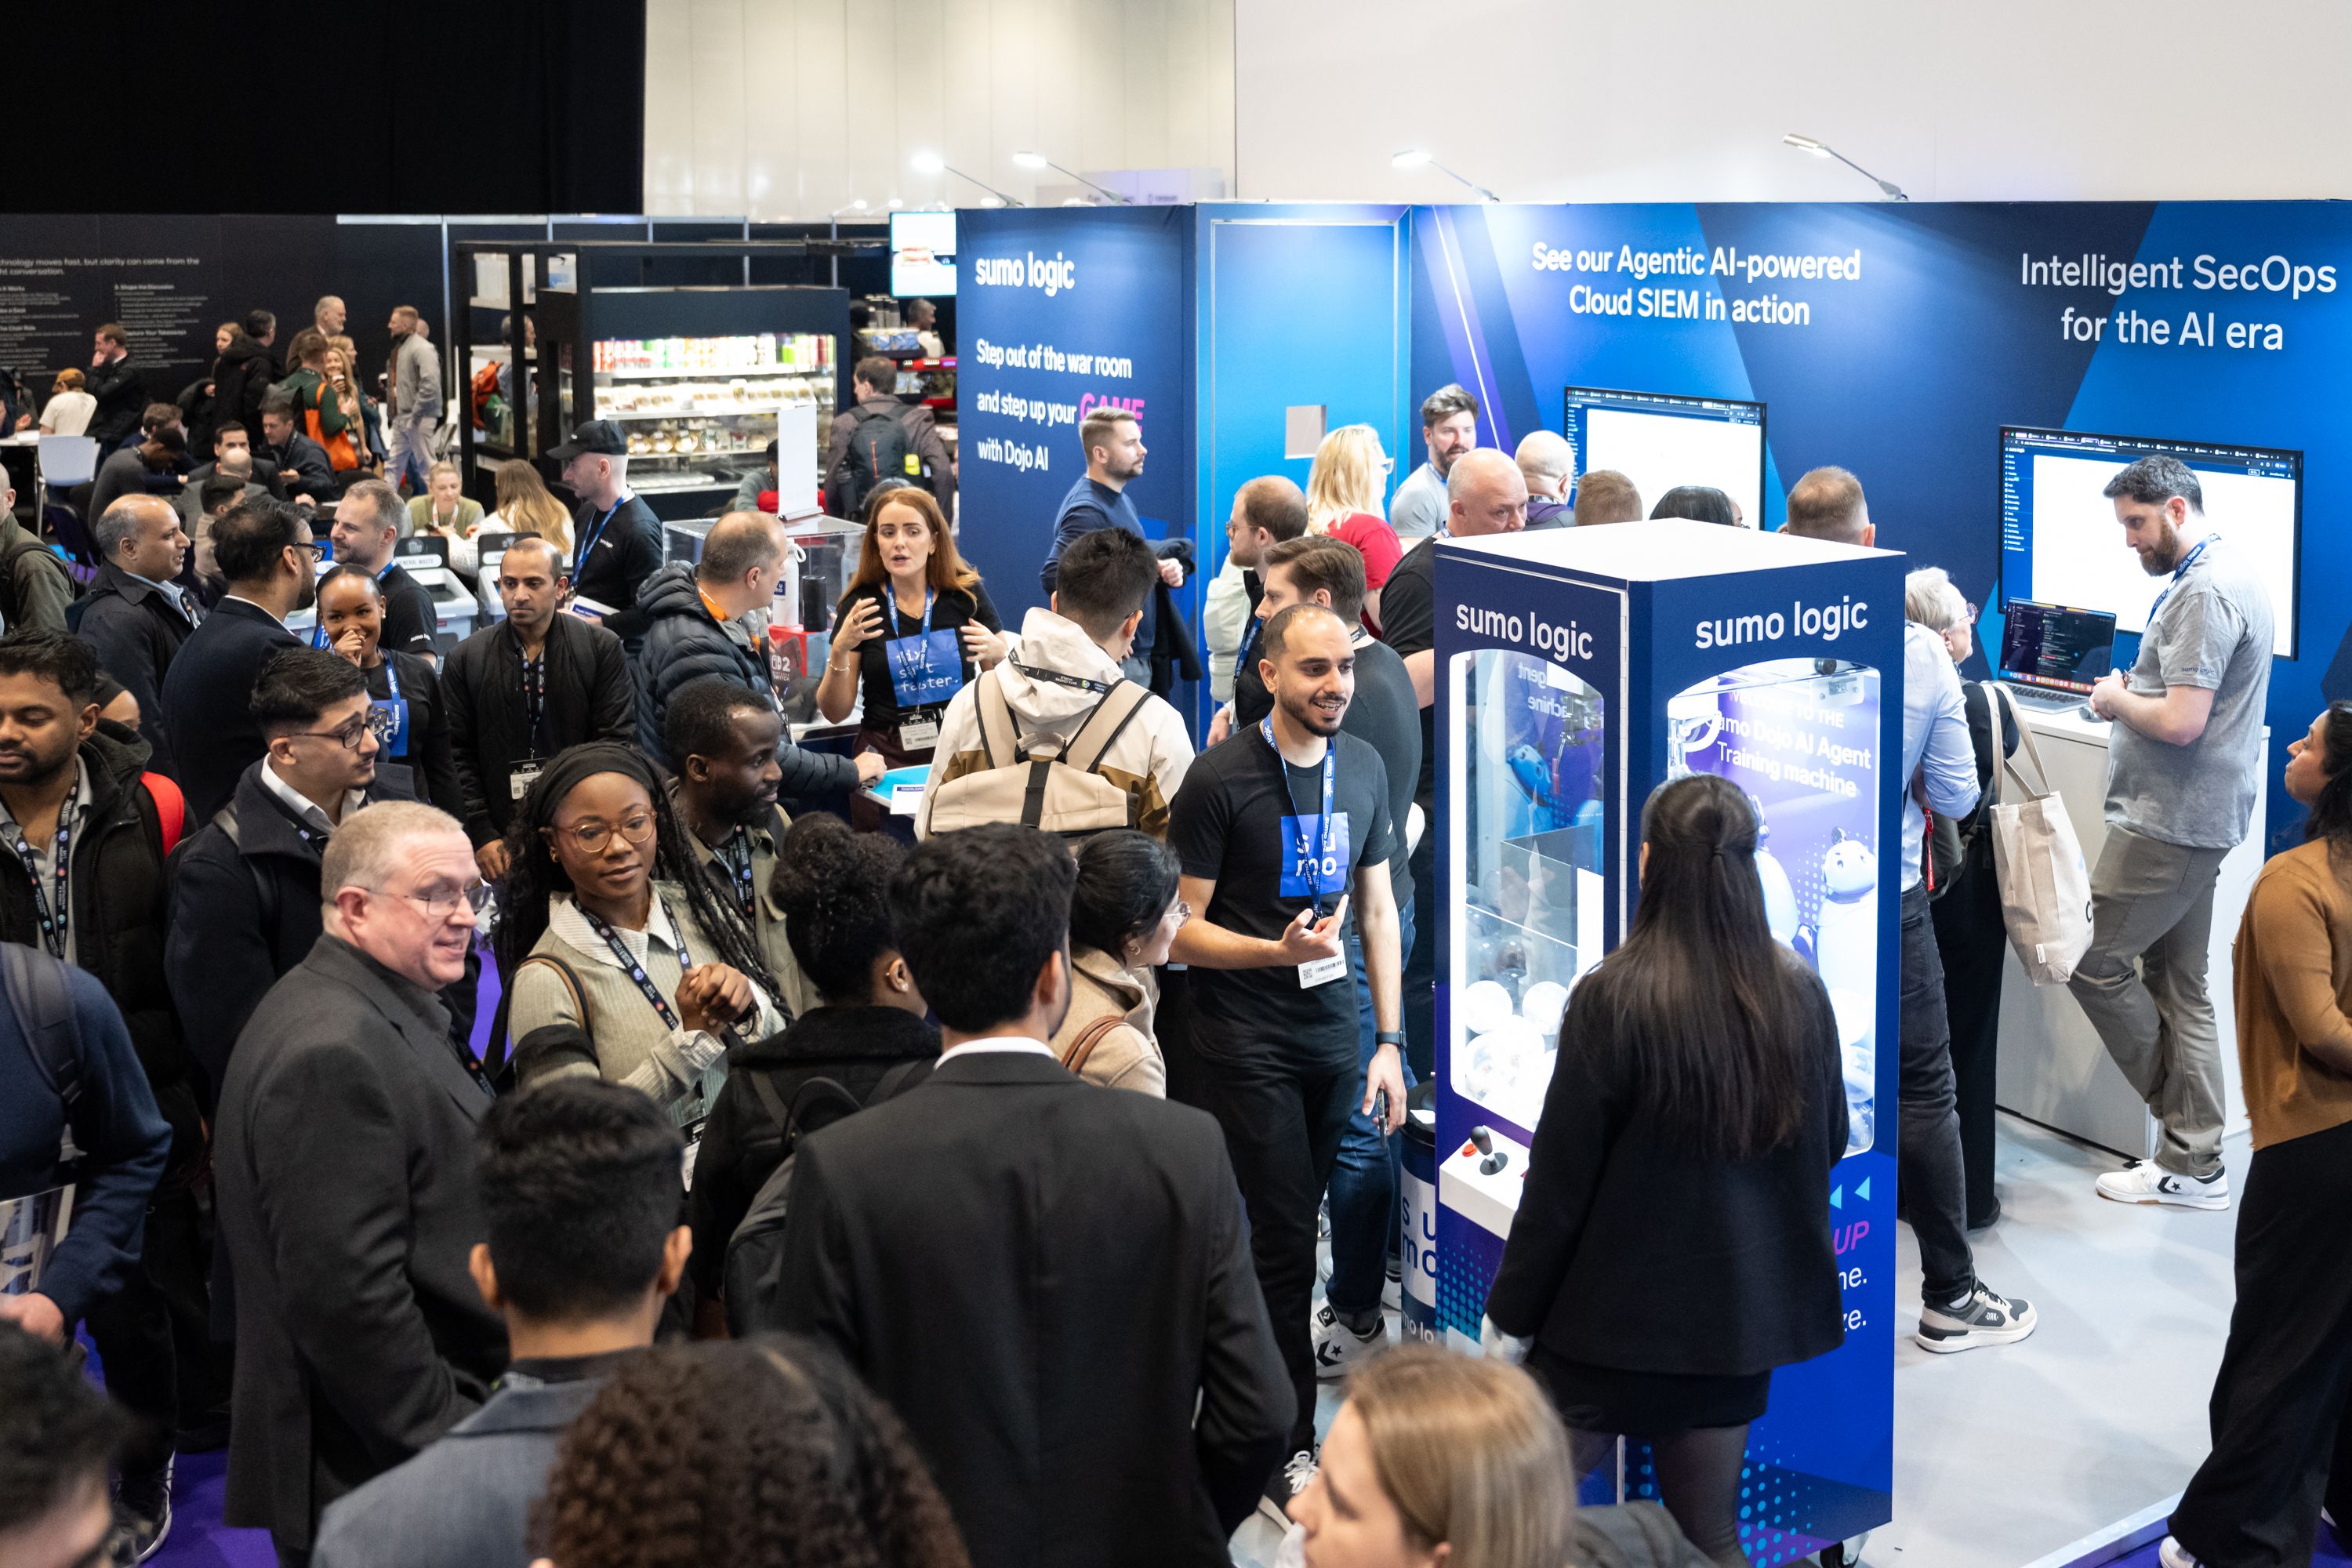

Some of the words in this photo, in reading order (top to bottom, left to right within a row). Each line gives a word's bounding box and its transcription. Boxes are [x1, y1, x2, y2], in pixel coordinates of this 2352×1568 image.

[100, 257, 124, 267] clarity
[975, 256, 1025, 288] sumo
[1028, 251, 1075, 296] logic
[1532, 241, 1572, 271] See
[1576, 250, 1613, 273] our
[1617, 245, 1704, 280] Agentic
[1709, 248, 1861, 283] AI-powered
[2022, 253, 2184, 296] Intelligent
[2193, 255, 2337, 299] SecOps
[1569, 285, 1632, 317] Cloud
[1637, 288, 1699, 320] SIEM
[1704, 291, 1726, 321] in
[1732, 294, 1810, 325] action
[2060, 307, 2107, 342] for
[2115, 310, 2170, 345] the
[2178, 311, 2216, 347] AI
[2225, 322, 2284, 350] era
[976, 338, 1004, 370] Step
[1006, 344, 1027, 368] out
[1029, 343, 1042, 368] of
[1044, 345, 1065, 372] the
[1067, 354, 1093, 375] war
[1094, 355, 1133, 379] room
[977, 390, 1000, 414] and
[1000, 392, 1028, 423] step
[1029, 402, 1047, 425] up
[1047, 402, 1077, 427] your
[978, 438, 1004, 464] with
[1004, 440, 1033, 472] Dojo
[1034, 446, 1049, 471] AI
[2187, 545, 2201, 561] sumo
[1456, 604, 1523, 643] sumo
[1530, 612, 1594, 662] logic
[1694, 612, 1784, 649] sumo
[1793, 595, 1869, 641] logic
[2199, 666, 2215, 675] logic
[1818, 709, 1845, 728] THE
[1719, 715, 1751, 738] umo
[1753, 719, 1793, 750] Dojo
[1794, 731, 1814, 754] AI
[1817, 736, 1872, 770] Agent
[1717, 740, 1780, 781] Training
[1784, 763, 1857, 798] machine
